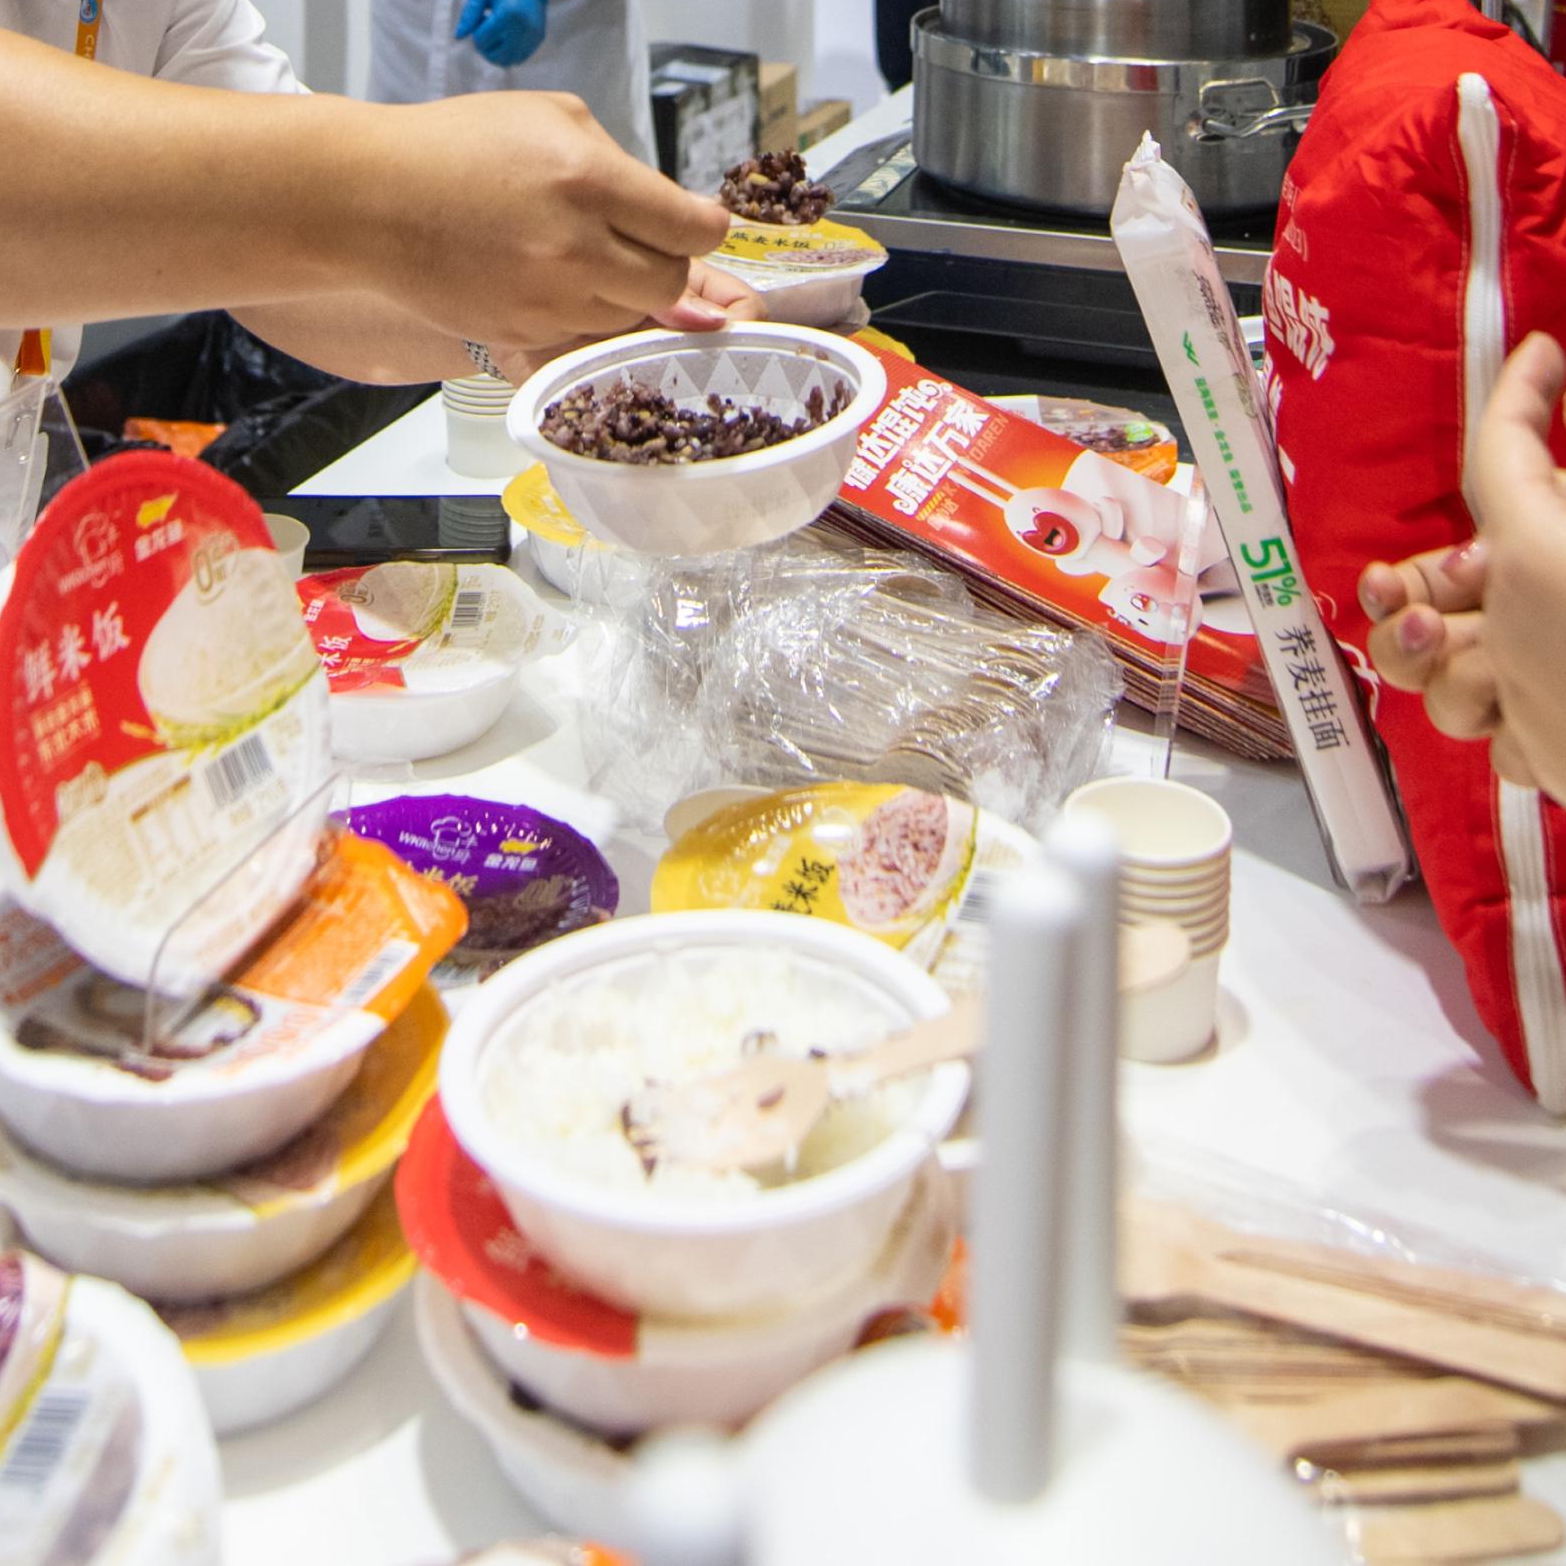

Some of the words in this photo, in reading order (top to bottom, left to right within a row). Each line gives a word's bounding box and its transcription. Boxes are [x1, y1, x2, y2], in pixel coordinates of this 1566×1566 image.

[1239, 535, 1302, 607] 51%
[1274, 622, 1351, 752] 荞麦挂面
